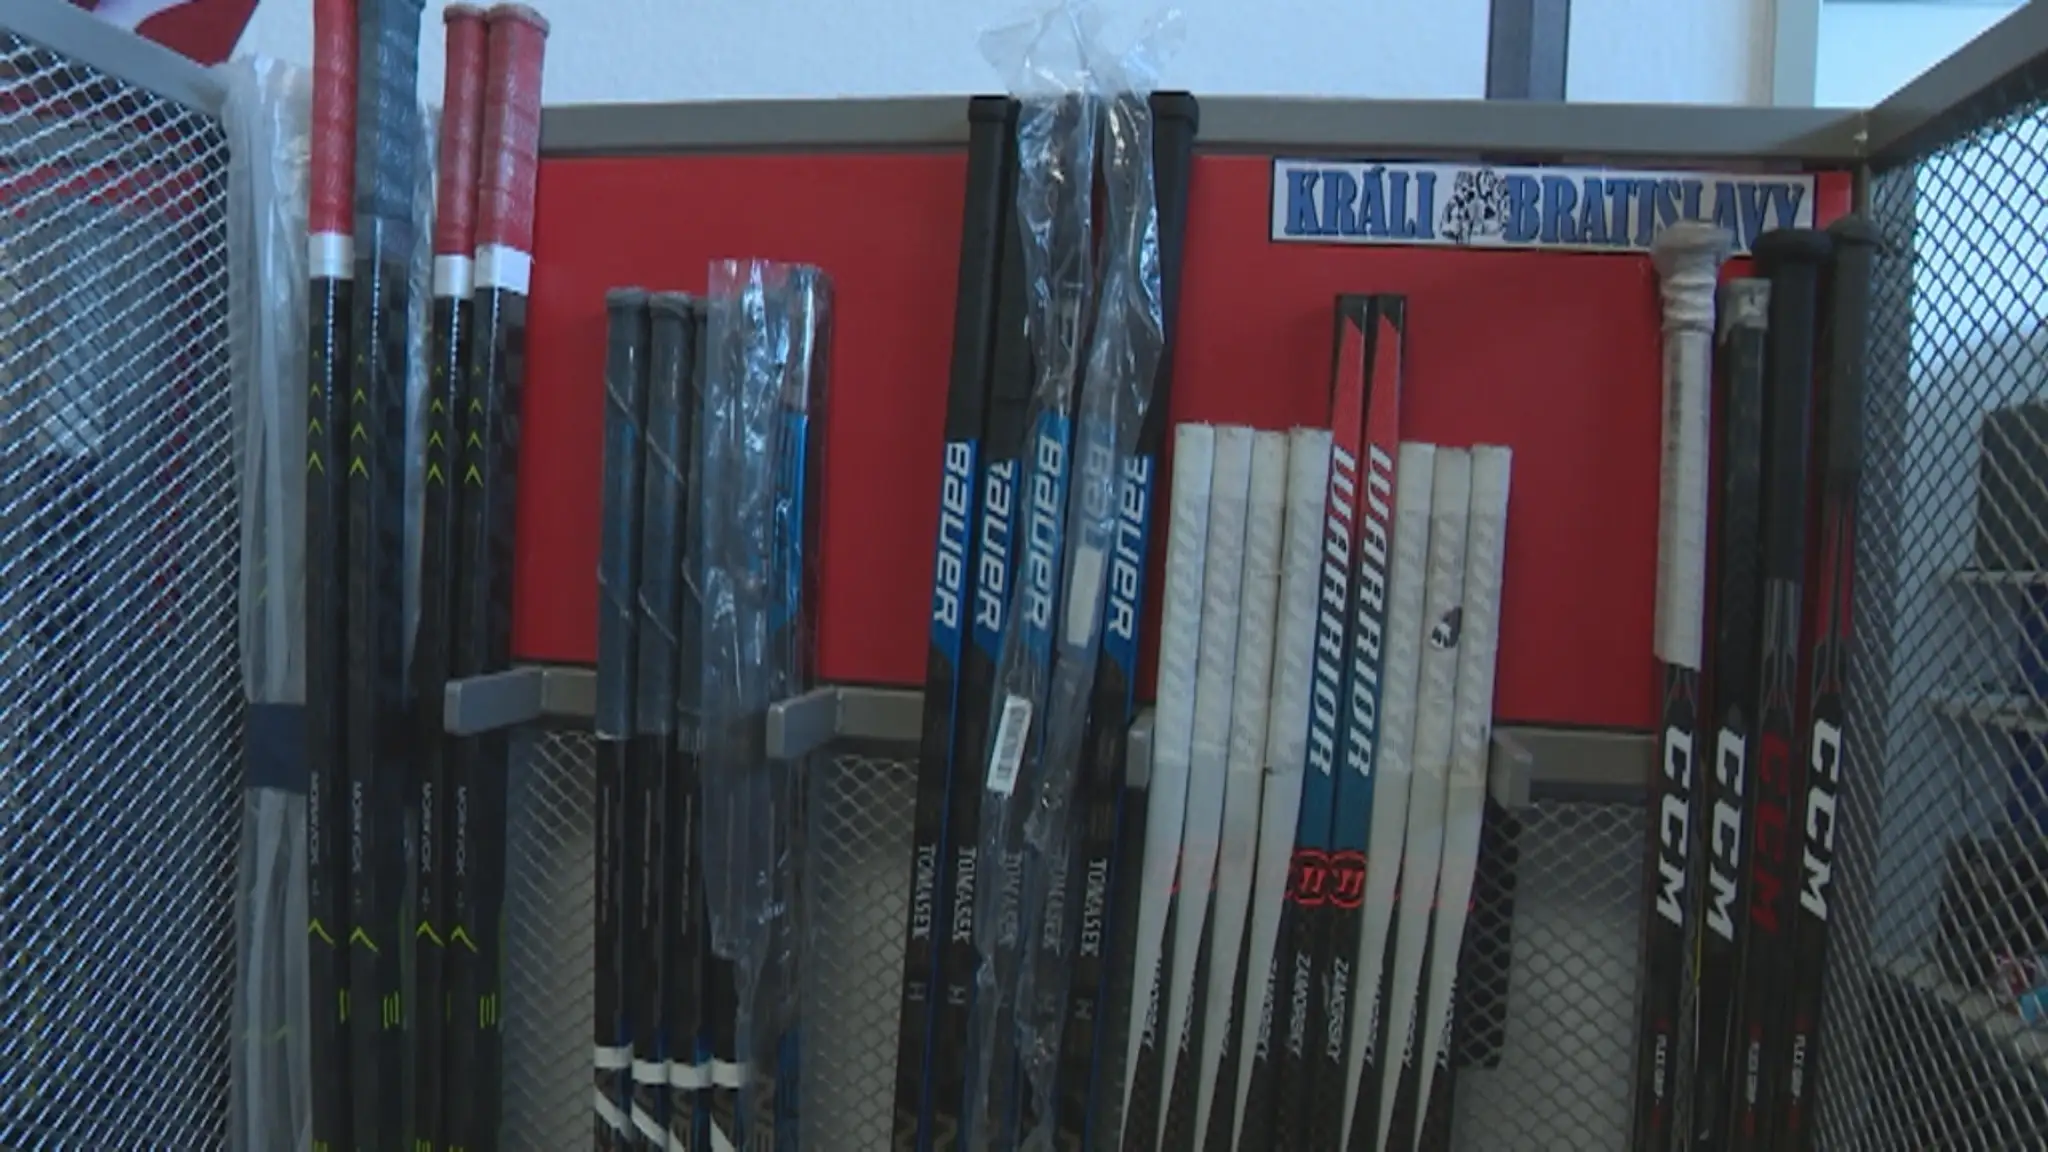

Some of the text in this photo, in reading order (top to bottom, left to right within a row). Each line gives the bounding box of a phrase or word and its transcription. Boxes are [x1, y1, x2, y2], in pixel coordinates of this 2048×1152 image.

[1284, 166, 1437, 241] KRÁLI
[933, 441, 971, 629] BAUER
[1023, 434, 1063, 631] BAUER
[1310, 444, 1357, 777] WARRIOR
[1347, 443, 1393, 778] WARRIOR
[1656, 724, 1694, 928] CCM
[1706, 725, 1747, 943] CCM
[1750, 729, 1790, 935] CCM
[1800, 716, 1842, 923] CCM
